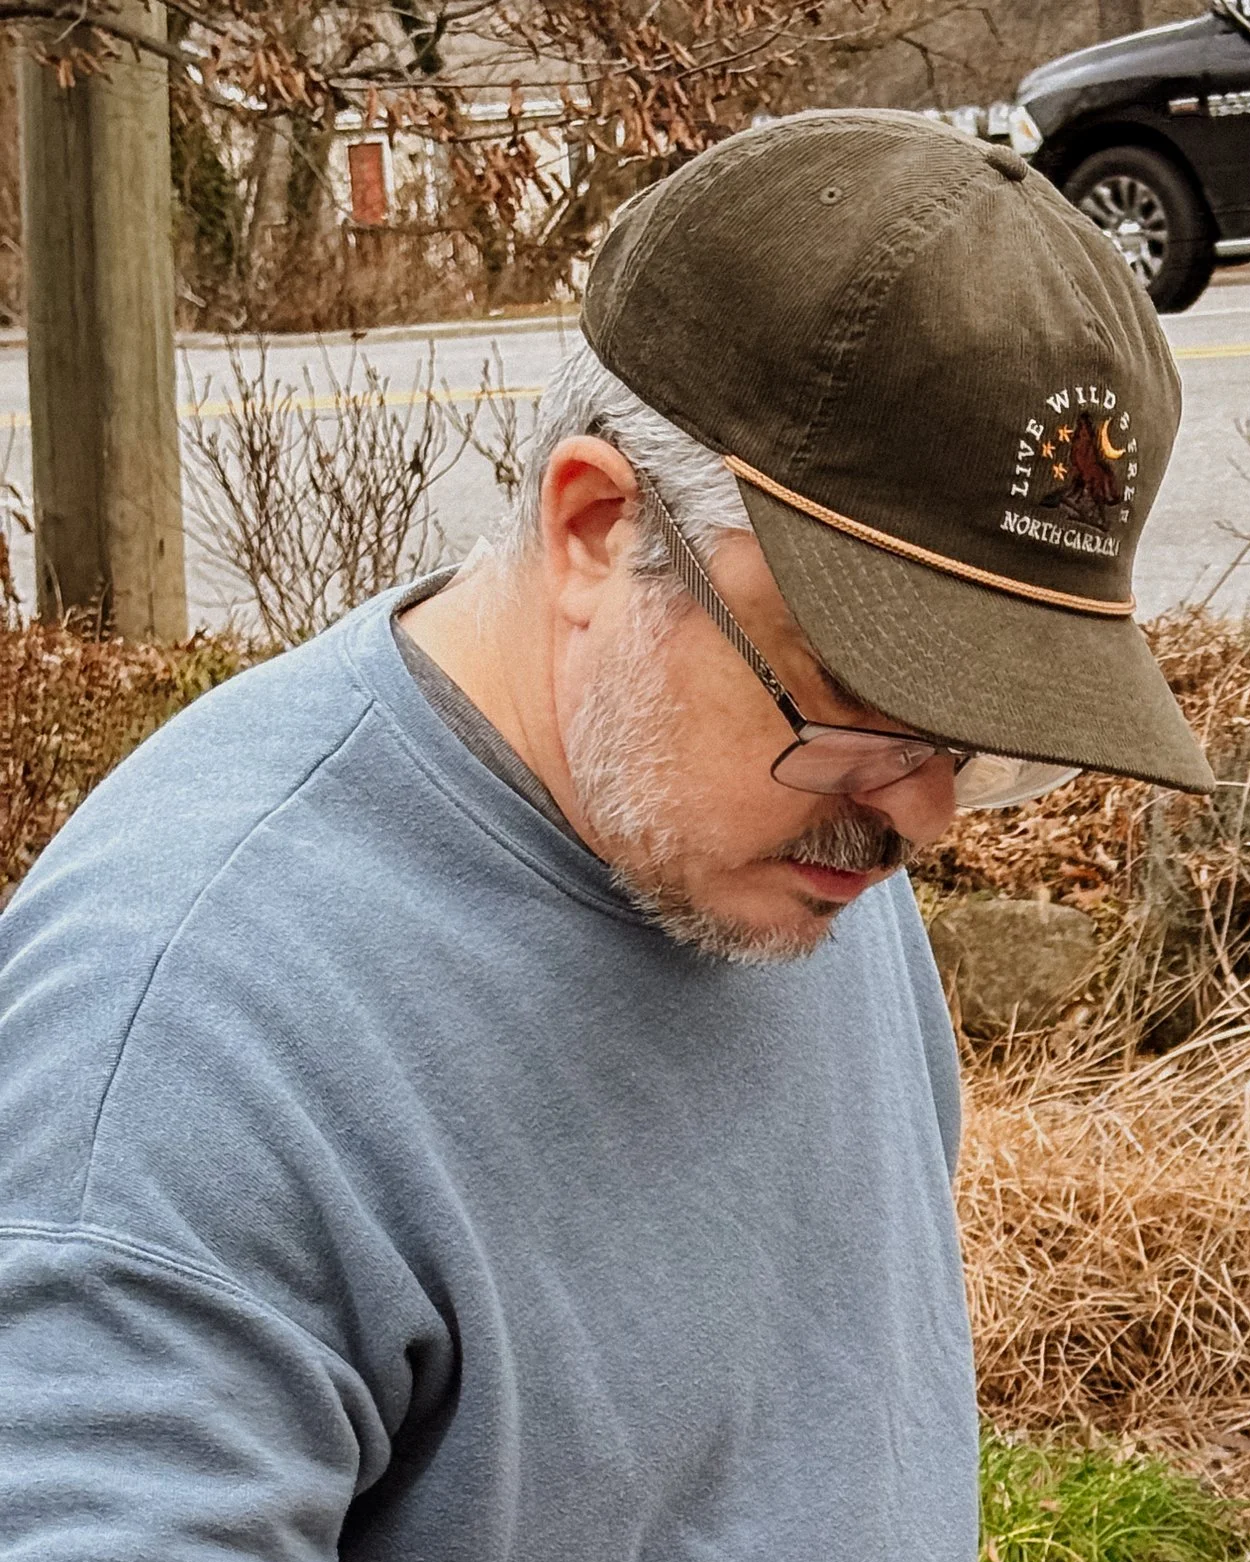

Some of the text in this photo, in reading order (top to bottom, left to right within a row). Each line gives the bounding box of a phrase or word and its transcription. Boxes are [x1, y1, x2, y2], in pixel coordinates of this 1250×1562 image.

[1011, 418, 1044, 497] LIVE
[1046, 386, 1116, 414] WILD
[1000, 510, 1061, 545] NORTH
